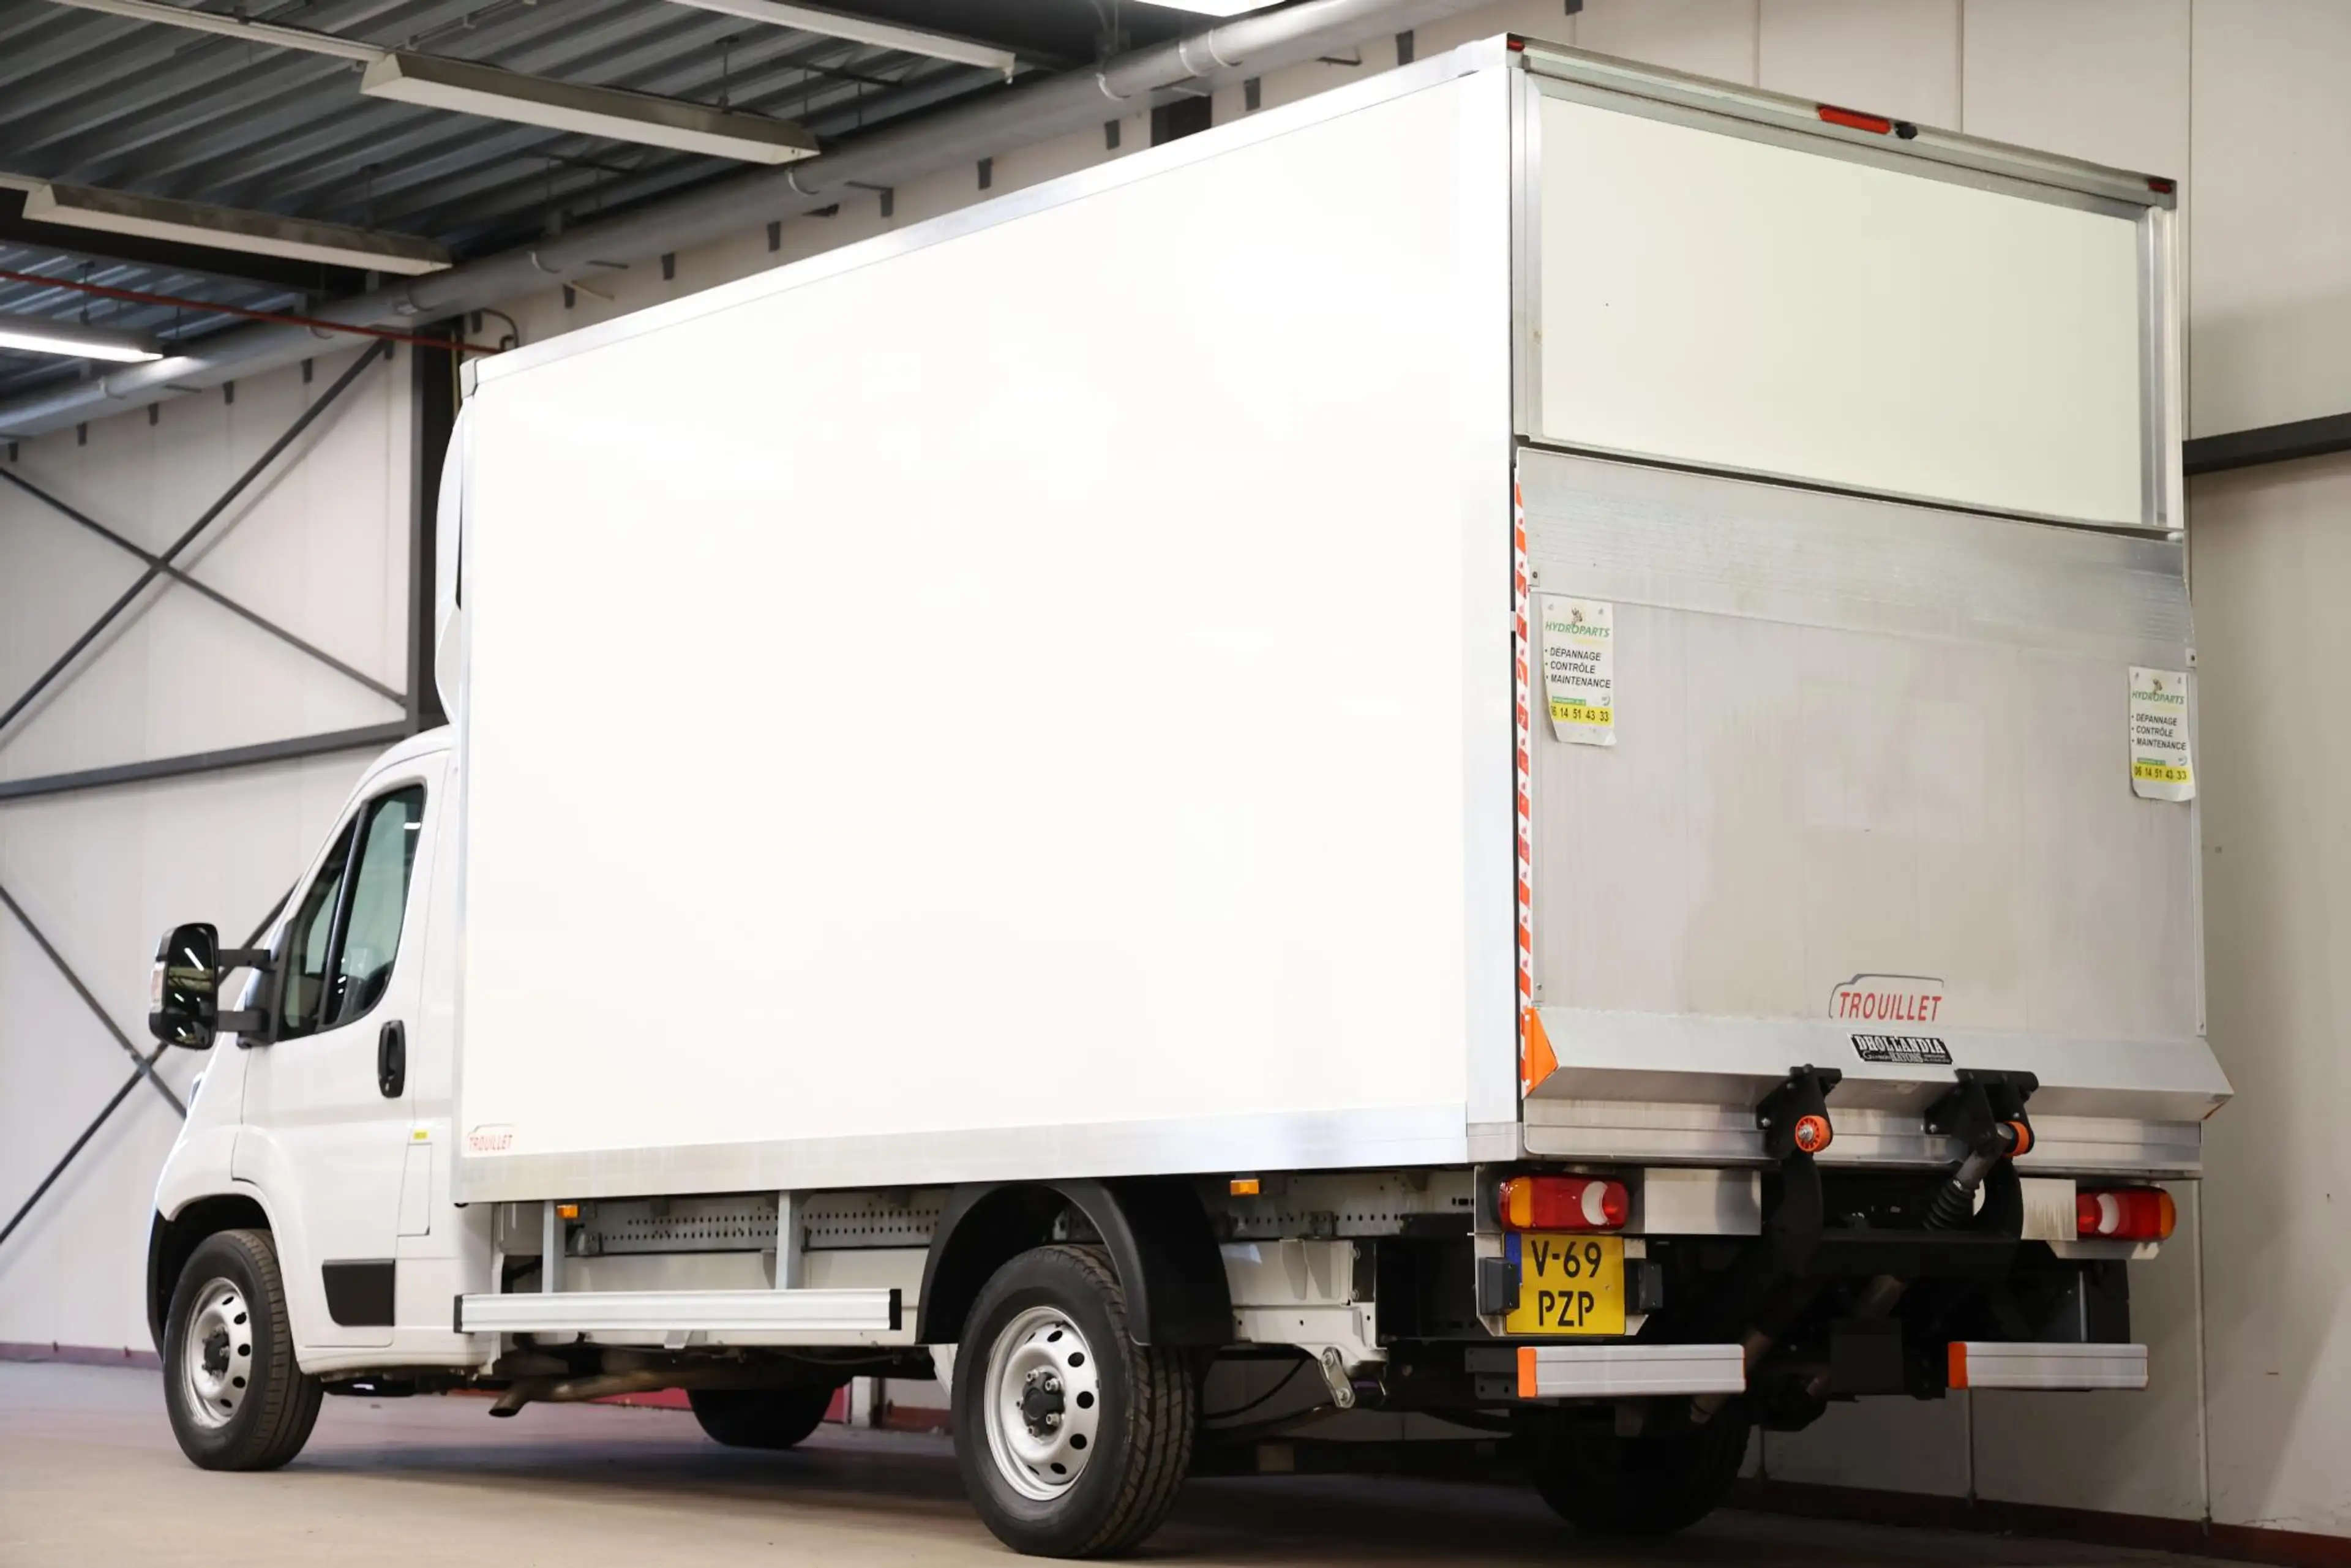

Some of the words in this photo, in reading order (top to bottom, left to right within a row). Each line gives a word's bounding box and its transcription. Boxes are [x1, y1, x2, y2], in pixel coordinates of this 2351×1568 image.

[1545, 621, 1610, 638] HYDROPARTS
[1550, 661, 1595, 674] CONTRÔLE
[1551, 675, 1611, 689] MAINTENANCE
[2131, 691, 2184, 705] HYDROPARTS
[1561, 707, 1569, 718] 14
[1573, 708, 1581, 719] 51
[1586, 709, 1595, 721] 43
[1600, 710, 1610, 722] 33
[2137, 737, 2186, 751] MAINTENANCE
[2145, 767, 2152, 777] 14
[2154, 768, 2162, 778] 51
[2177, 770, 2187, 780] 33
[1840, 991, 1942, 1022] TROUILLET
[1854, 1035, 1946, 1054] DHOLLANDIA
[469, 1133, 513, 1152] TROUILLET
[1531, 1240, 1602, 1278] V-69
[1538, 1290, 1595, 1327] PZP
